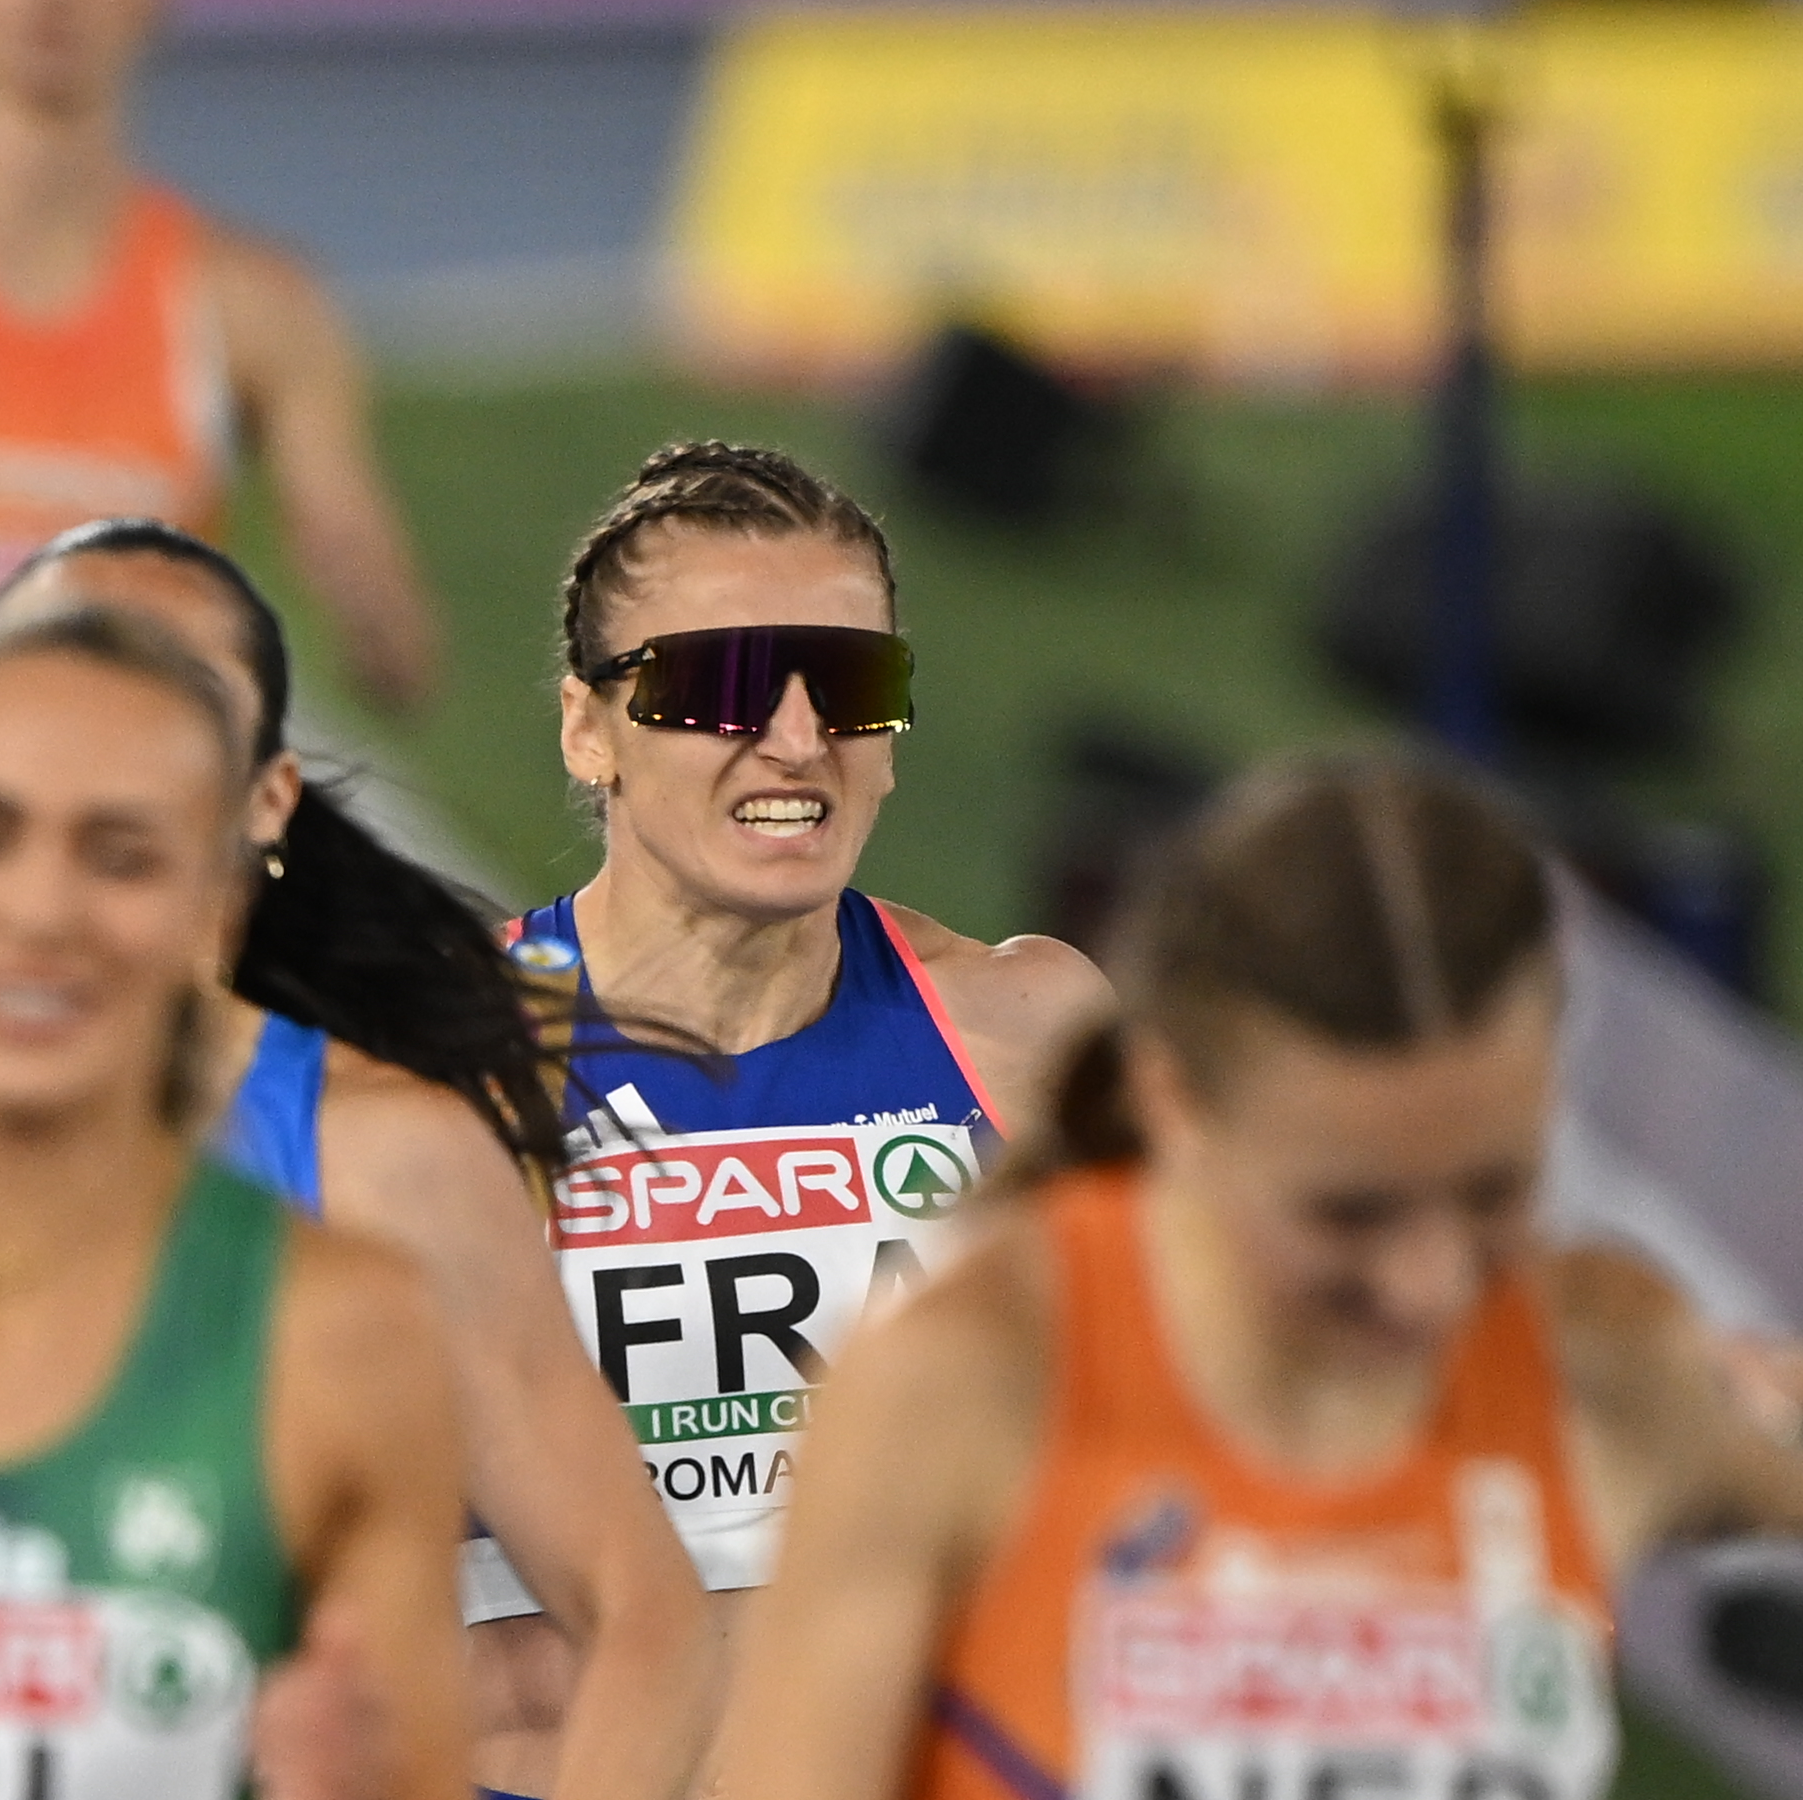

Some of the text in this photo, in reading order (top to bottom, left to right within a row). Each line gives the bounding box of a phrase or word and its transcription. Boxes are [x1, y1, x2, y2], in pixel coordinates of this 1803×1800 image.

[873, 1102, 939, 1128] Mutuel
[554, 1149, 861, 1234] SPAR
[651, 1408, 661, 1439] I
[671, 1398, 759, 1437] RUN
